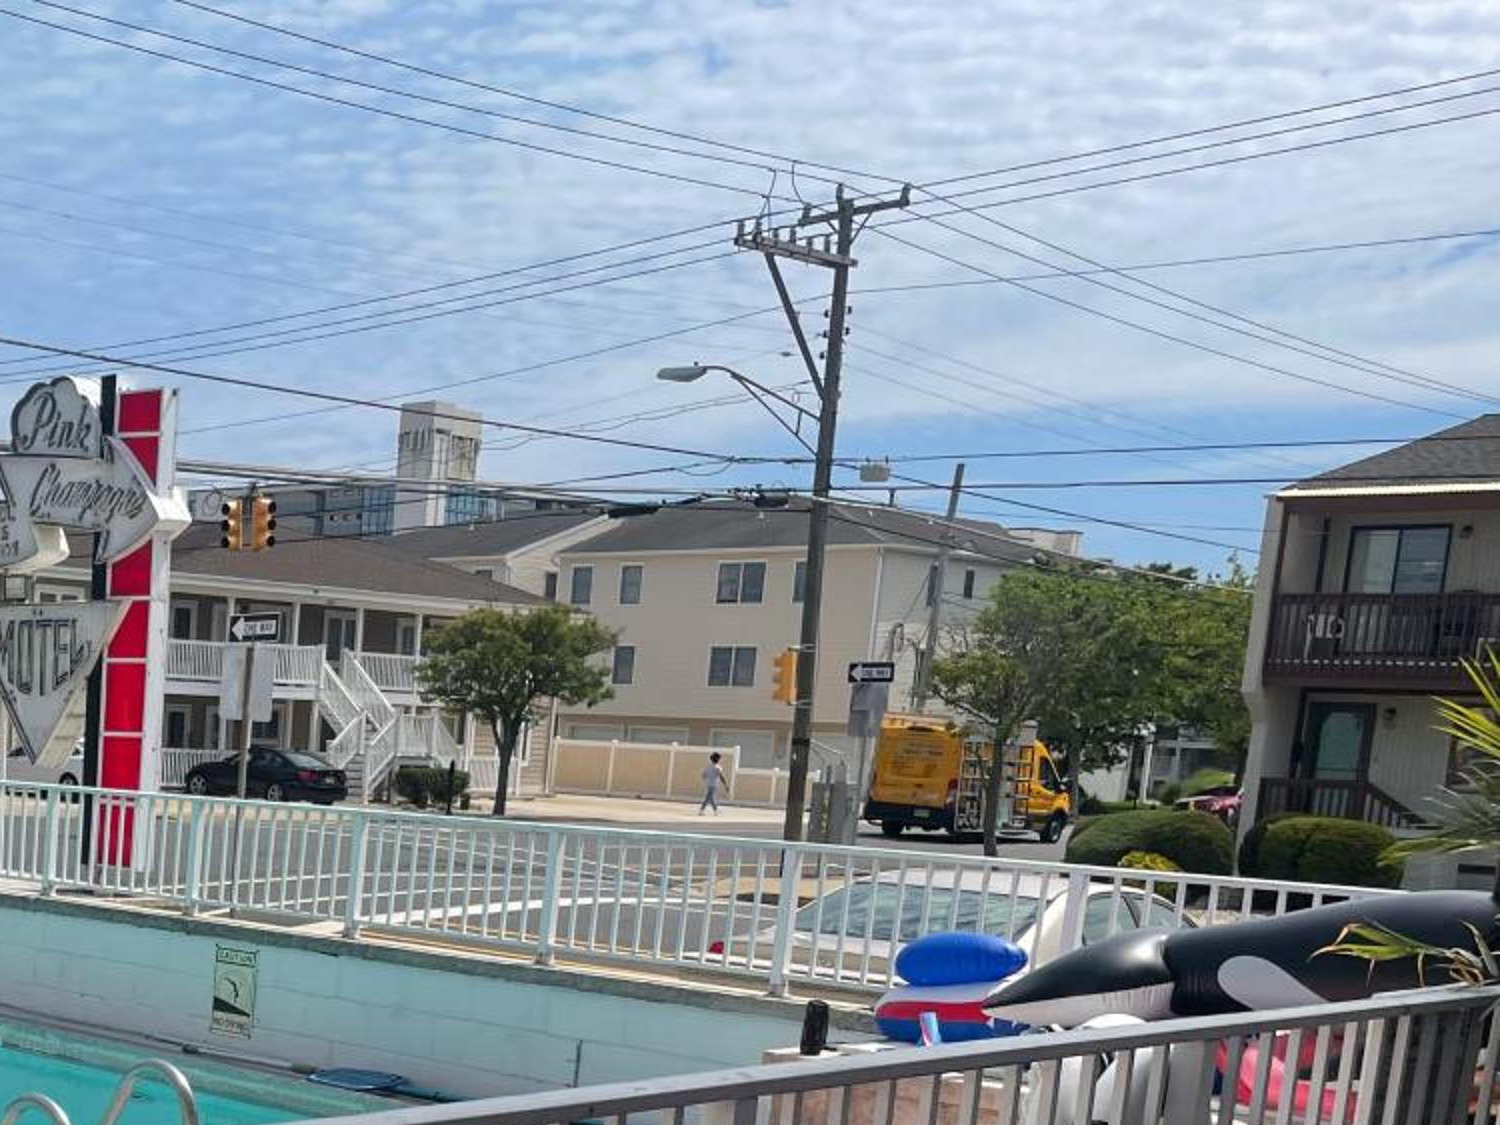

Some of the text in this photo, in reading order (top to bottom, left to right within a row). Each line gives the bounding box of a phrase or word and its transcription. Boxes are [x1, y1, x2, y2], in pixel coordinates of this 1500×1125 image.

[17, 391, 92, 451] Pink
[30, 463, 145, 524] Champagne
[259, 622, 274, 634] WAY
